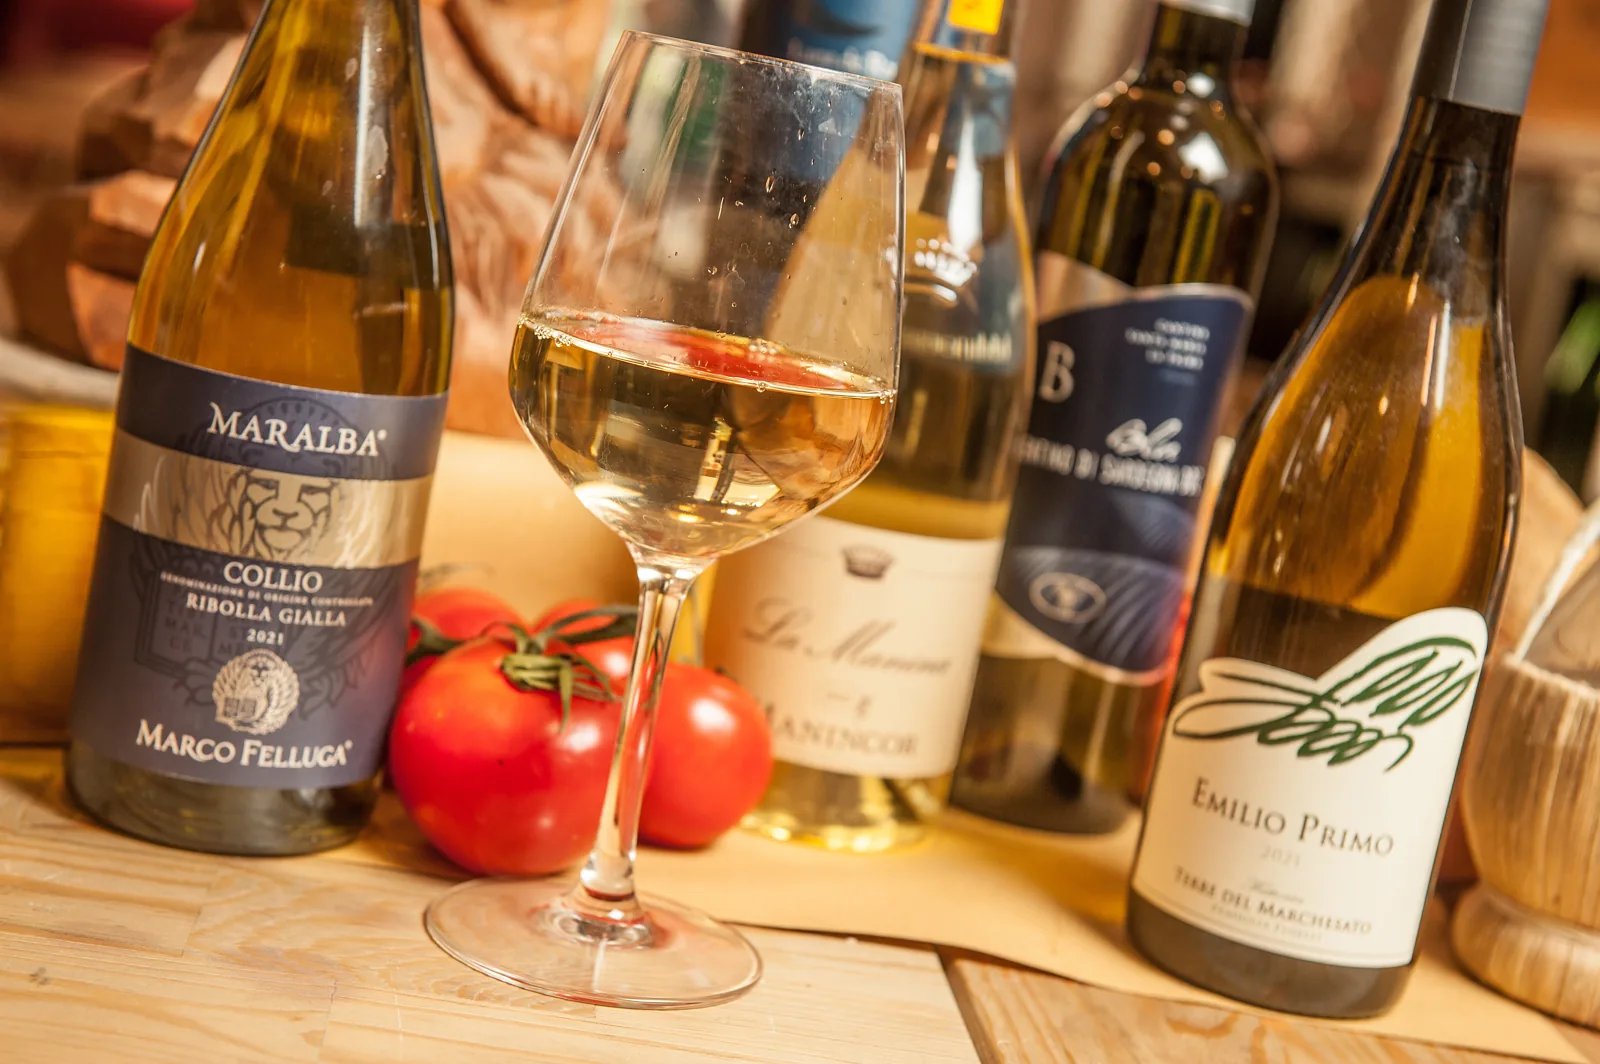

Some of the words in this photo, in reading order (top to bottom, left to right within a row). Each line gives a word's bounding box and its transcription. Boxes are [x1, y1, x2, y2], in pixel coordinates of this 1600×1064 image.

[206, 402, 379, 457] MARALBA
[223, 561, 323, 593] COLLIO
[186, 592, 271, 622] RIBOLLA
[278, 607, 346, 627] GIALLA
[246, 628, 284, 646] 2021
[136, 718, 236, 764] MARCO
[239, 738, 348, 769] FELLUGA
[1191, 776, 1286, 836] EMILIO
[1298, 813, 1395, 857] PRIMO
